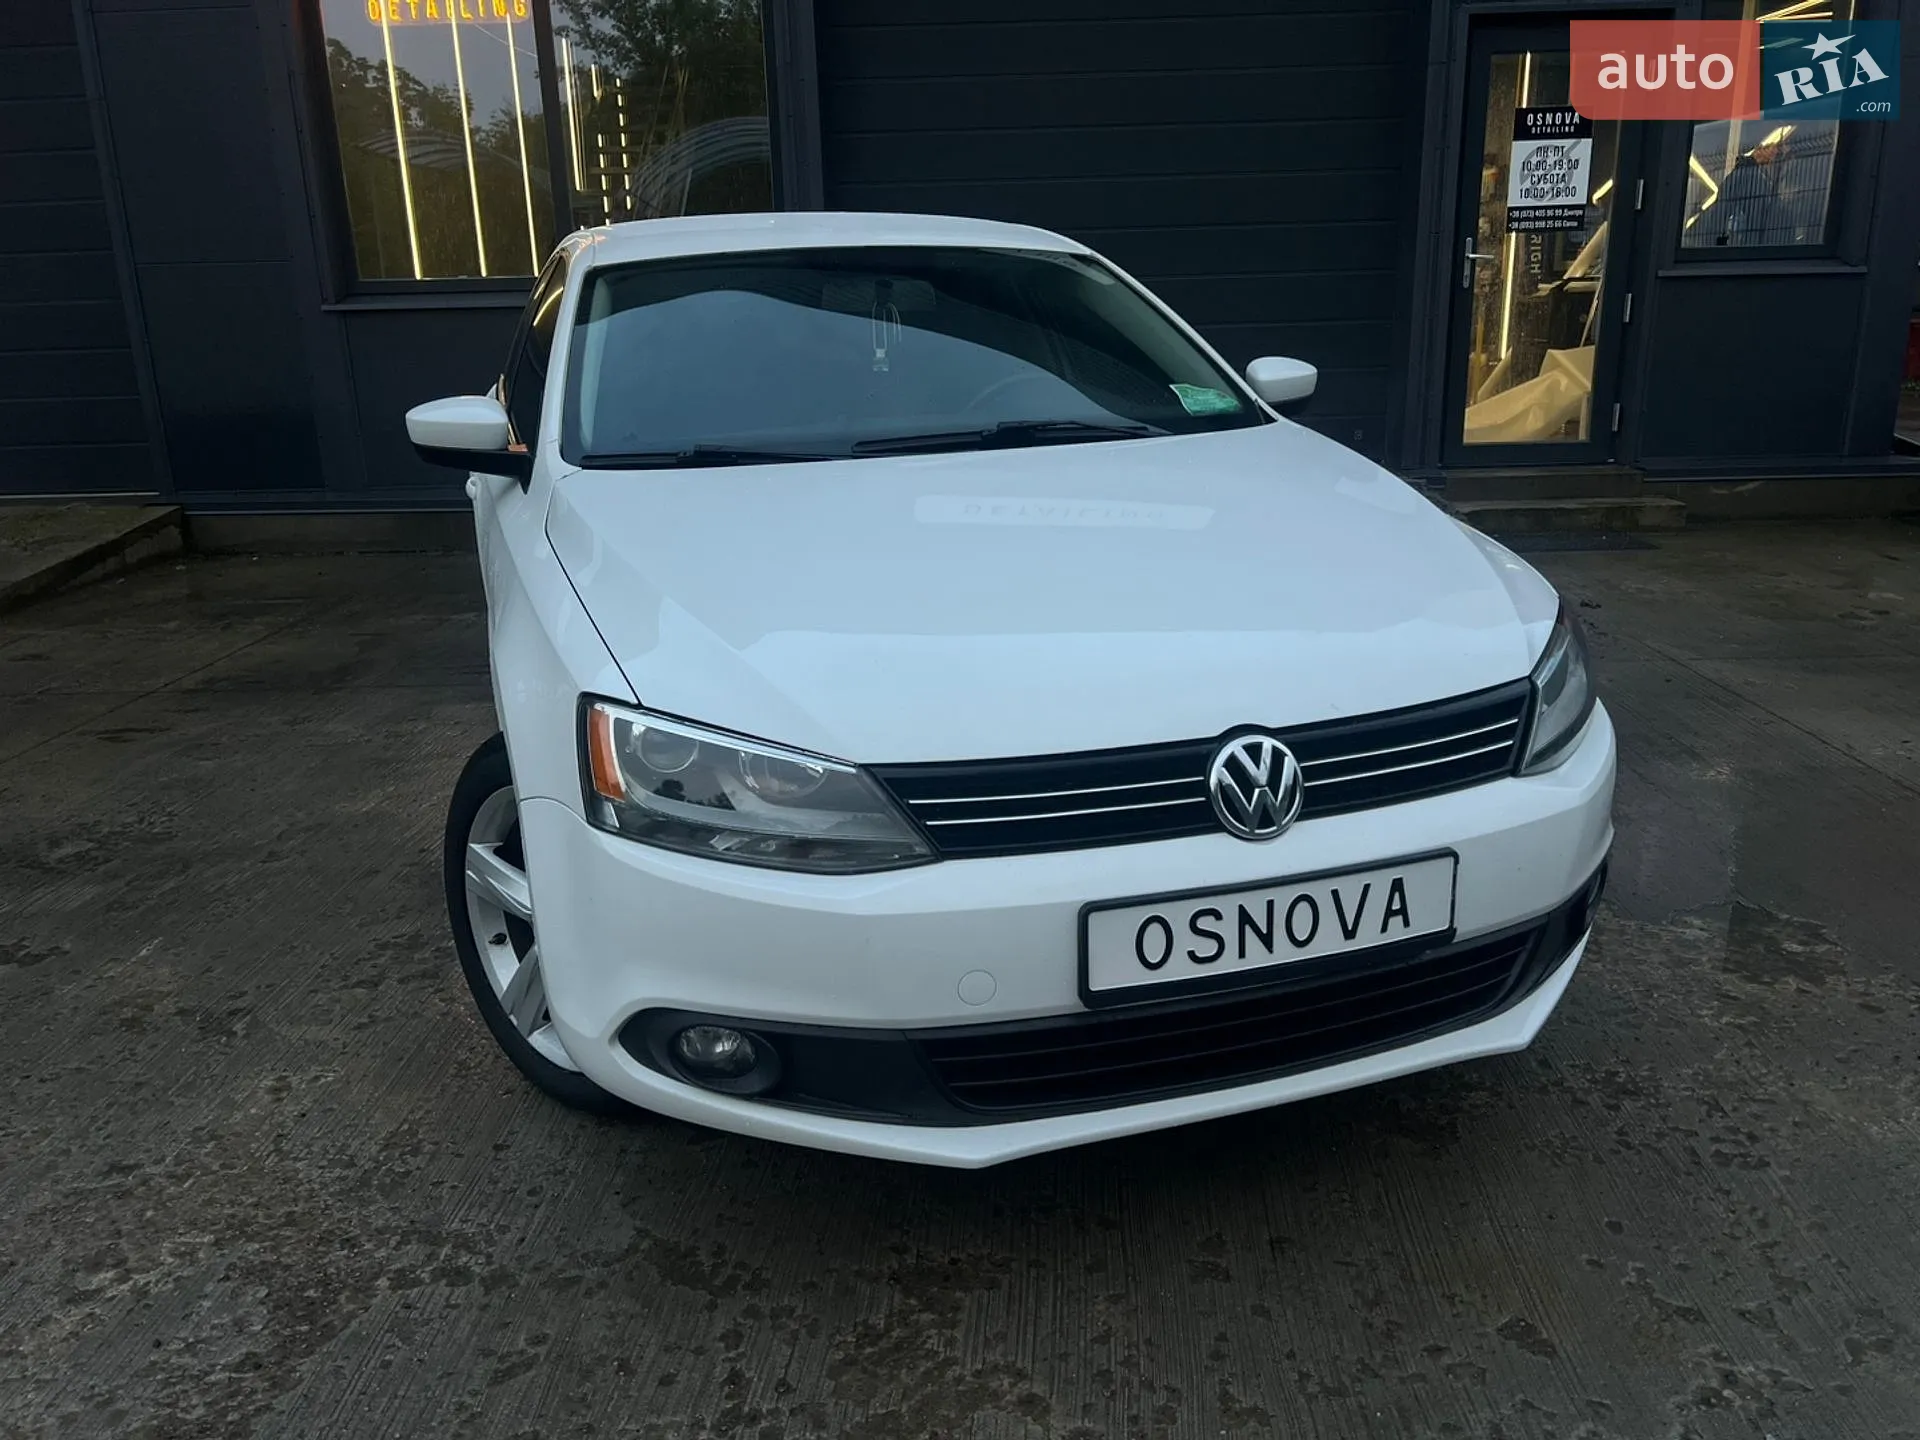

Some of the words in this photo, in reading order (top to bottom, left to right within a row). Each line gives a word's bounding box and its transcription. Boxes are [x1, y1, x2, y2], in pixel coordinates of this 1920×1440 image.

[367, 0, 527, 21] DETAILING
[1526, 112, 1580, 126] OSNOVA
[1531, 125, 1575, 134] DETAILING
[1535, 146, 1566, 158] ПН-ПТ
[1530, 173, 1567, 185] СУБОТА
[1530, 234, 1542, 279] RIGH
[1135, 876, 1411, 971] OSNOVA
